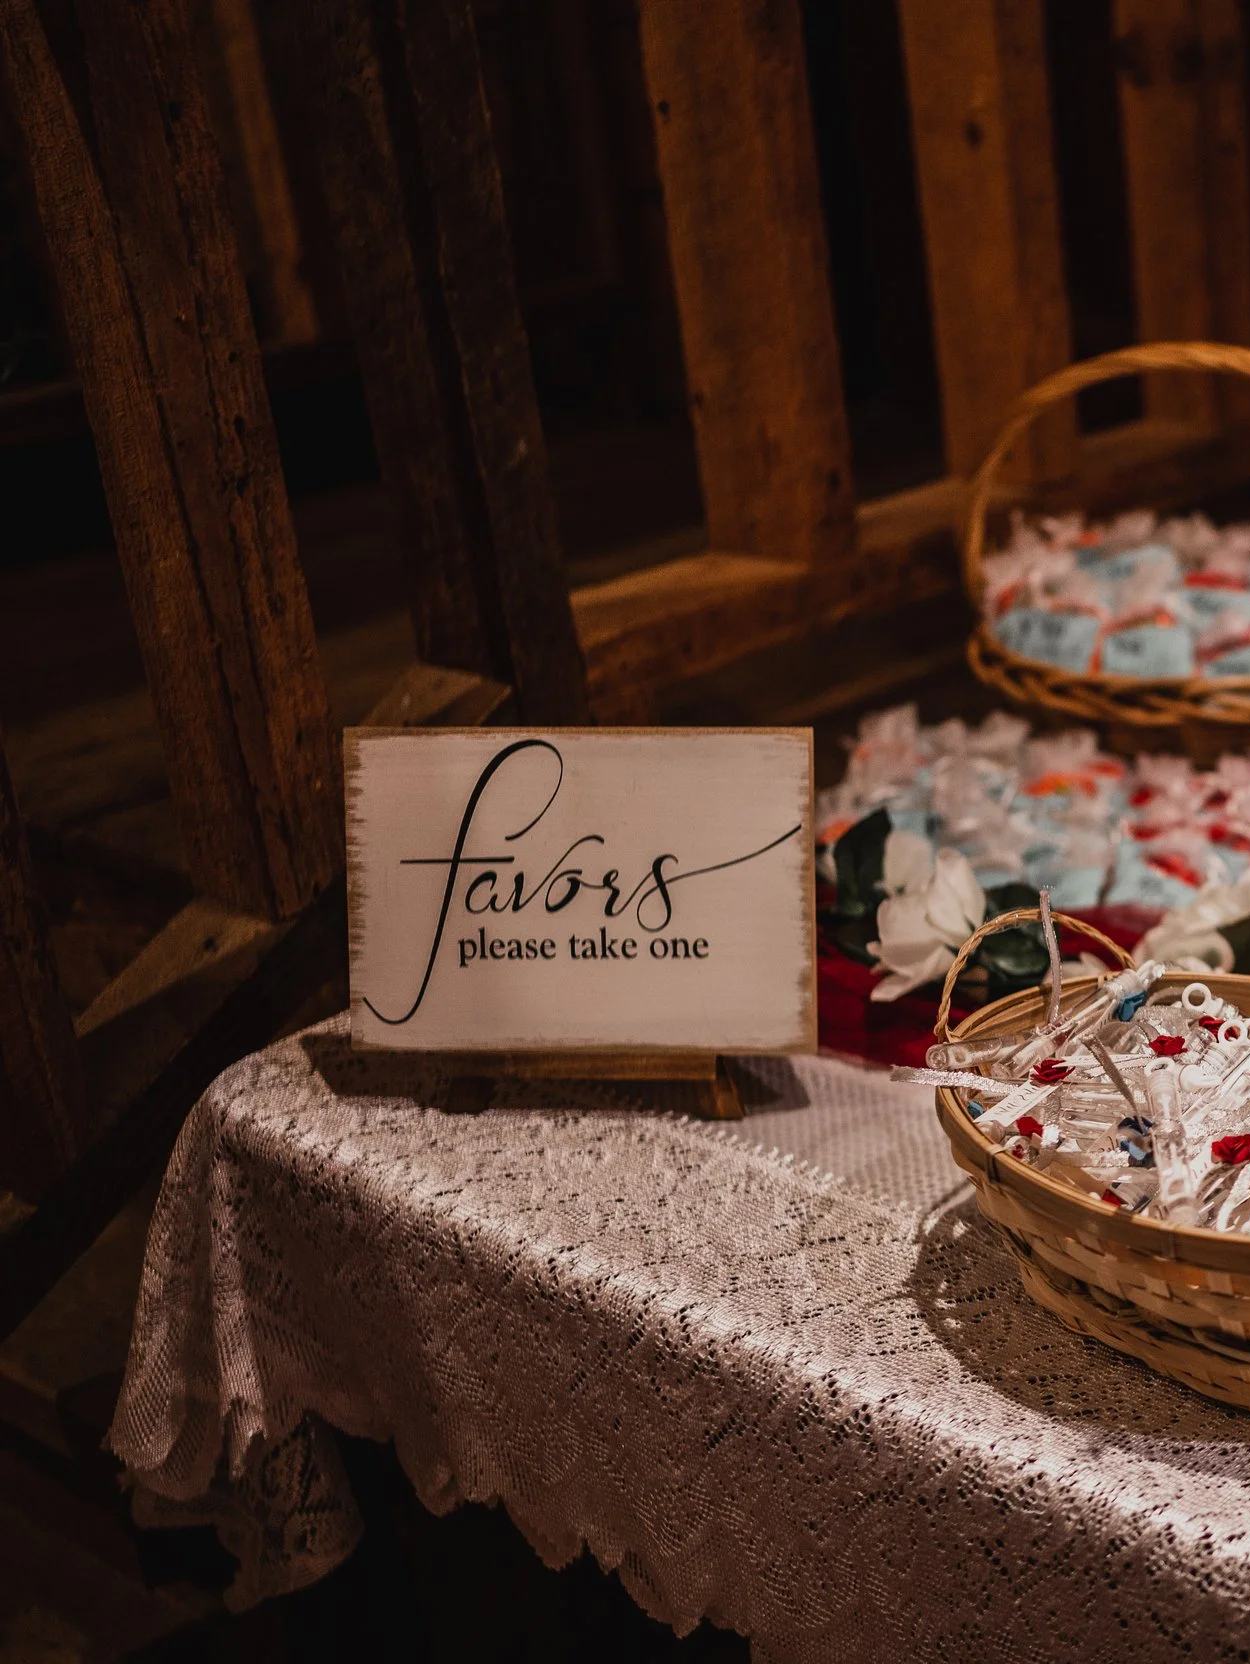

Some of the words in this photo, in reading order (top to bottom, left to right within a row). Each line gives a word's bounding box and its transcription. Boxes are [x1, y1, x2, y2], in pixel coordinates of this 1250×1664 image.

[363, 738, 802, 1025] favors
[458, 927, 556, 968] please
[568, 926, 638, 960] take
[649, 938, 710, 960] one
